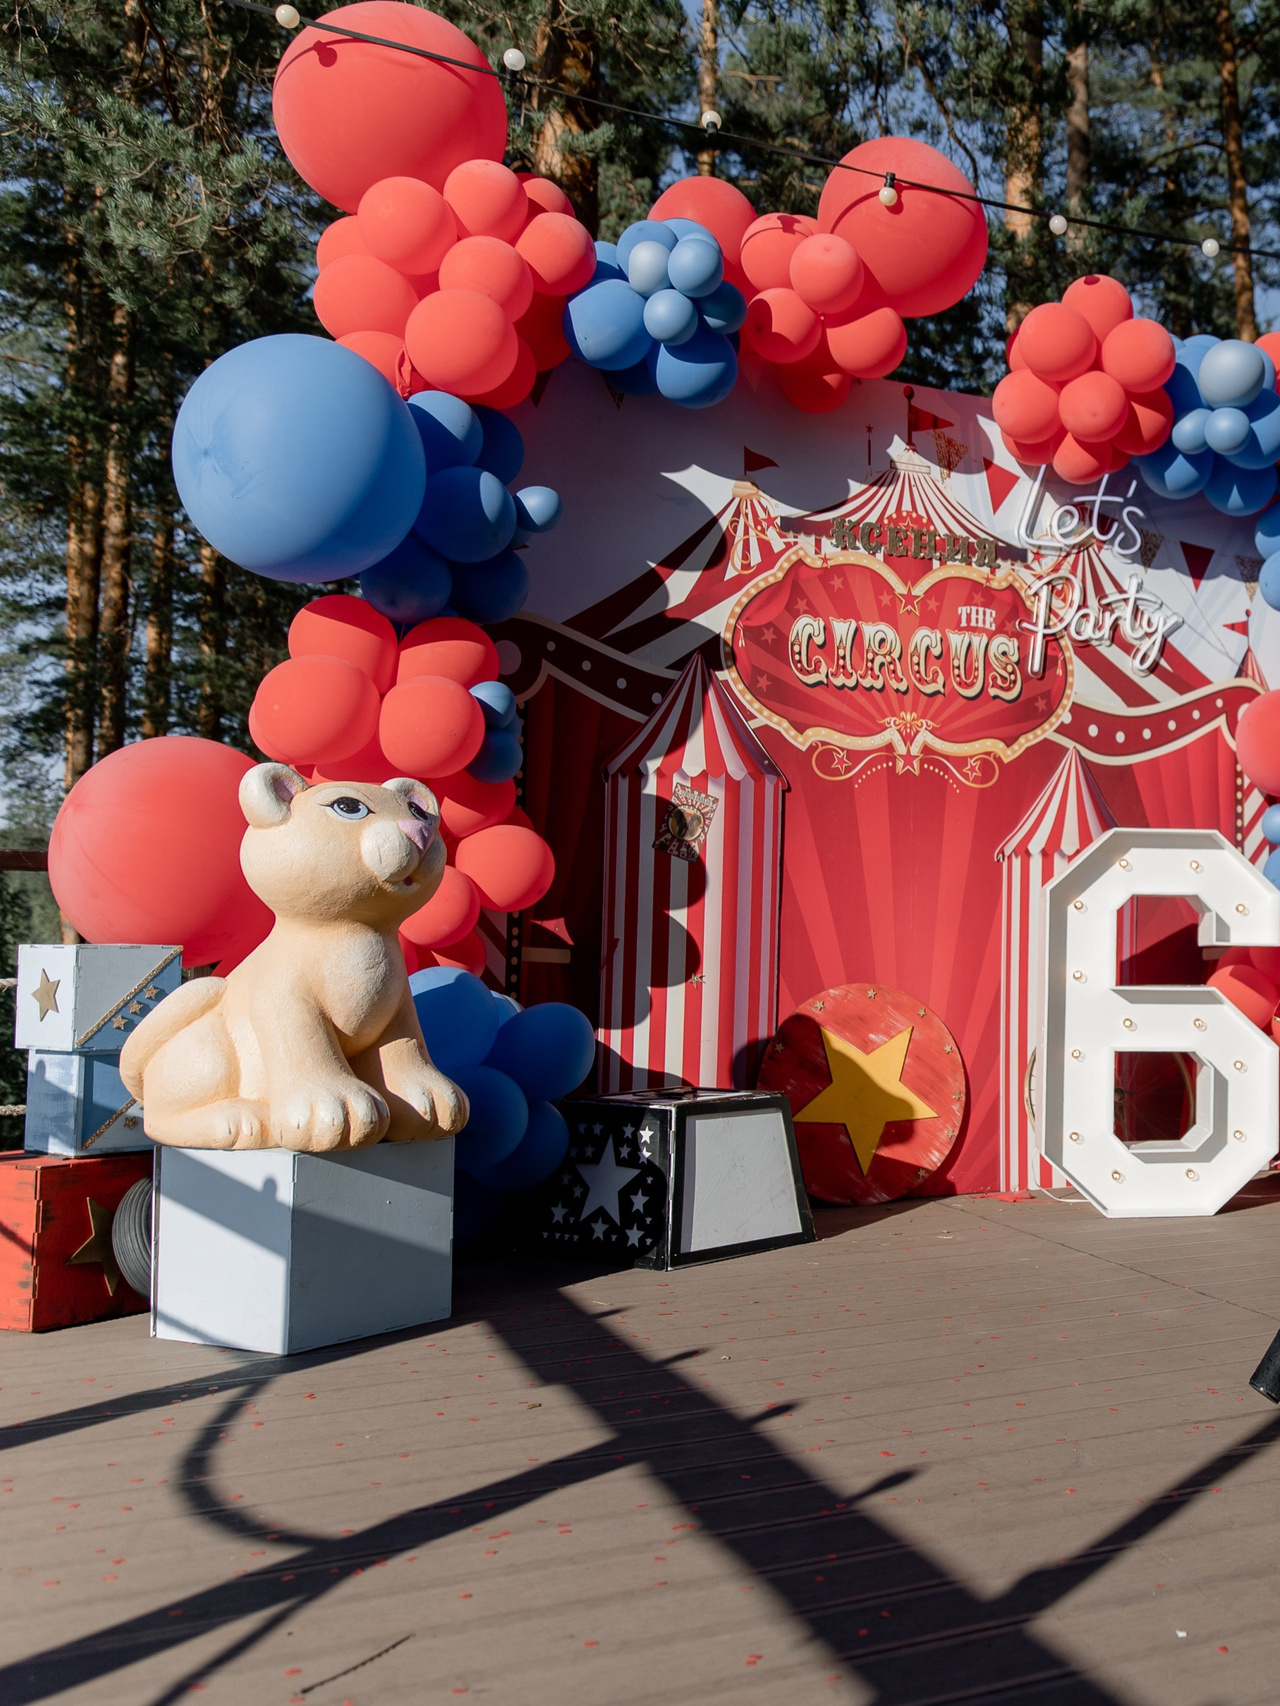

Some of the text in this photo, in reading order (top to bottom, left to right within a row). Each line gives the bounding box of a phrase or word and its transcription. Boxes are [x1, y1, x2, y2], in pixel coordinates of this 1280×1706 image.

[830, 517, 1001, 568] КСЕНИЯ
[1018, 464, 1146, 555] Let's
[788, 614, 1023, 704] CIRCUS
[958, 606, 996, 631] THE
[1018, 575, 1183, 676] Party
[1041, 827, 1280, 1218] 6
